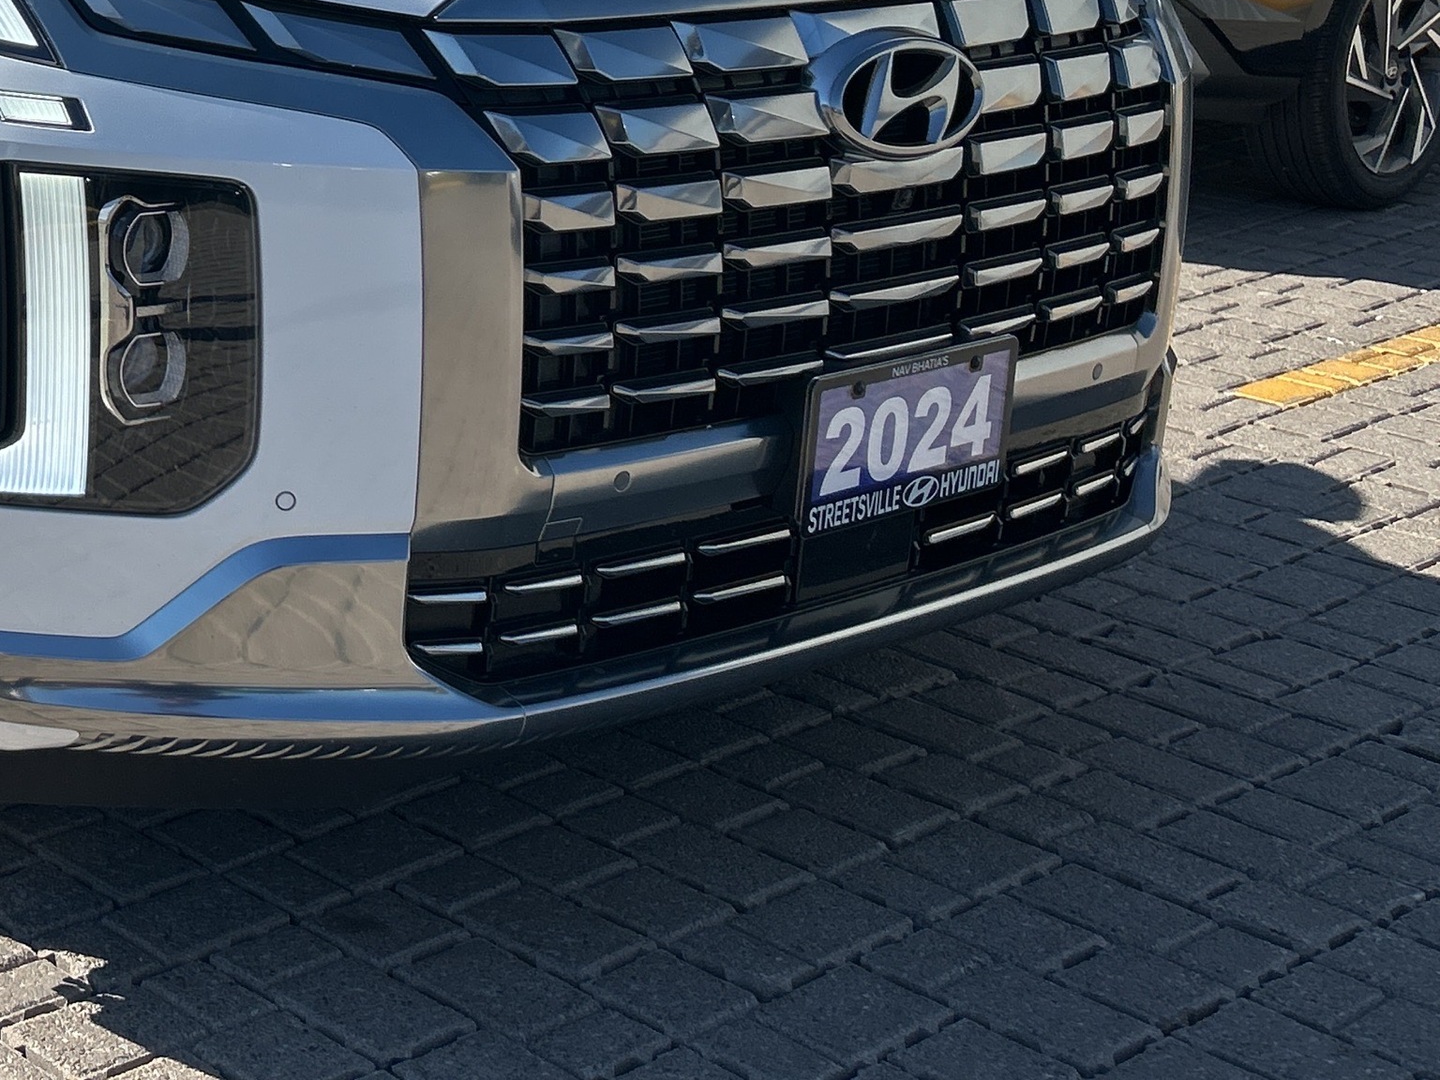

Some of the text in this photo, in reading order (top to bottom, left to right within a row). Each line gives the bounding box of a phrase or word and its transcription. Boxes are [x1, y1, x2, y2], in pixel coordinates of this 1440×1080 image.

[892, 355, 949, 378] NAV BHATIA'S
[819, 374, 993, 497] 2024
[807, 459, 1000, 534] STREETSVILLE HYUNDAI
